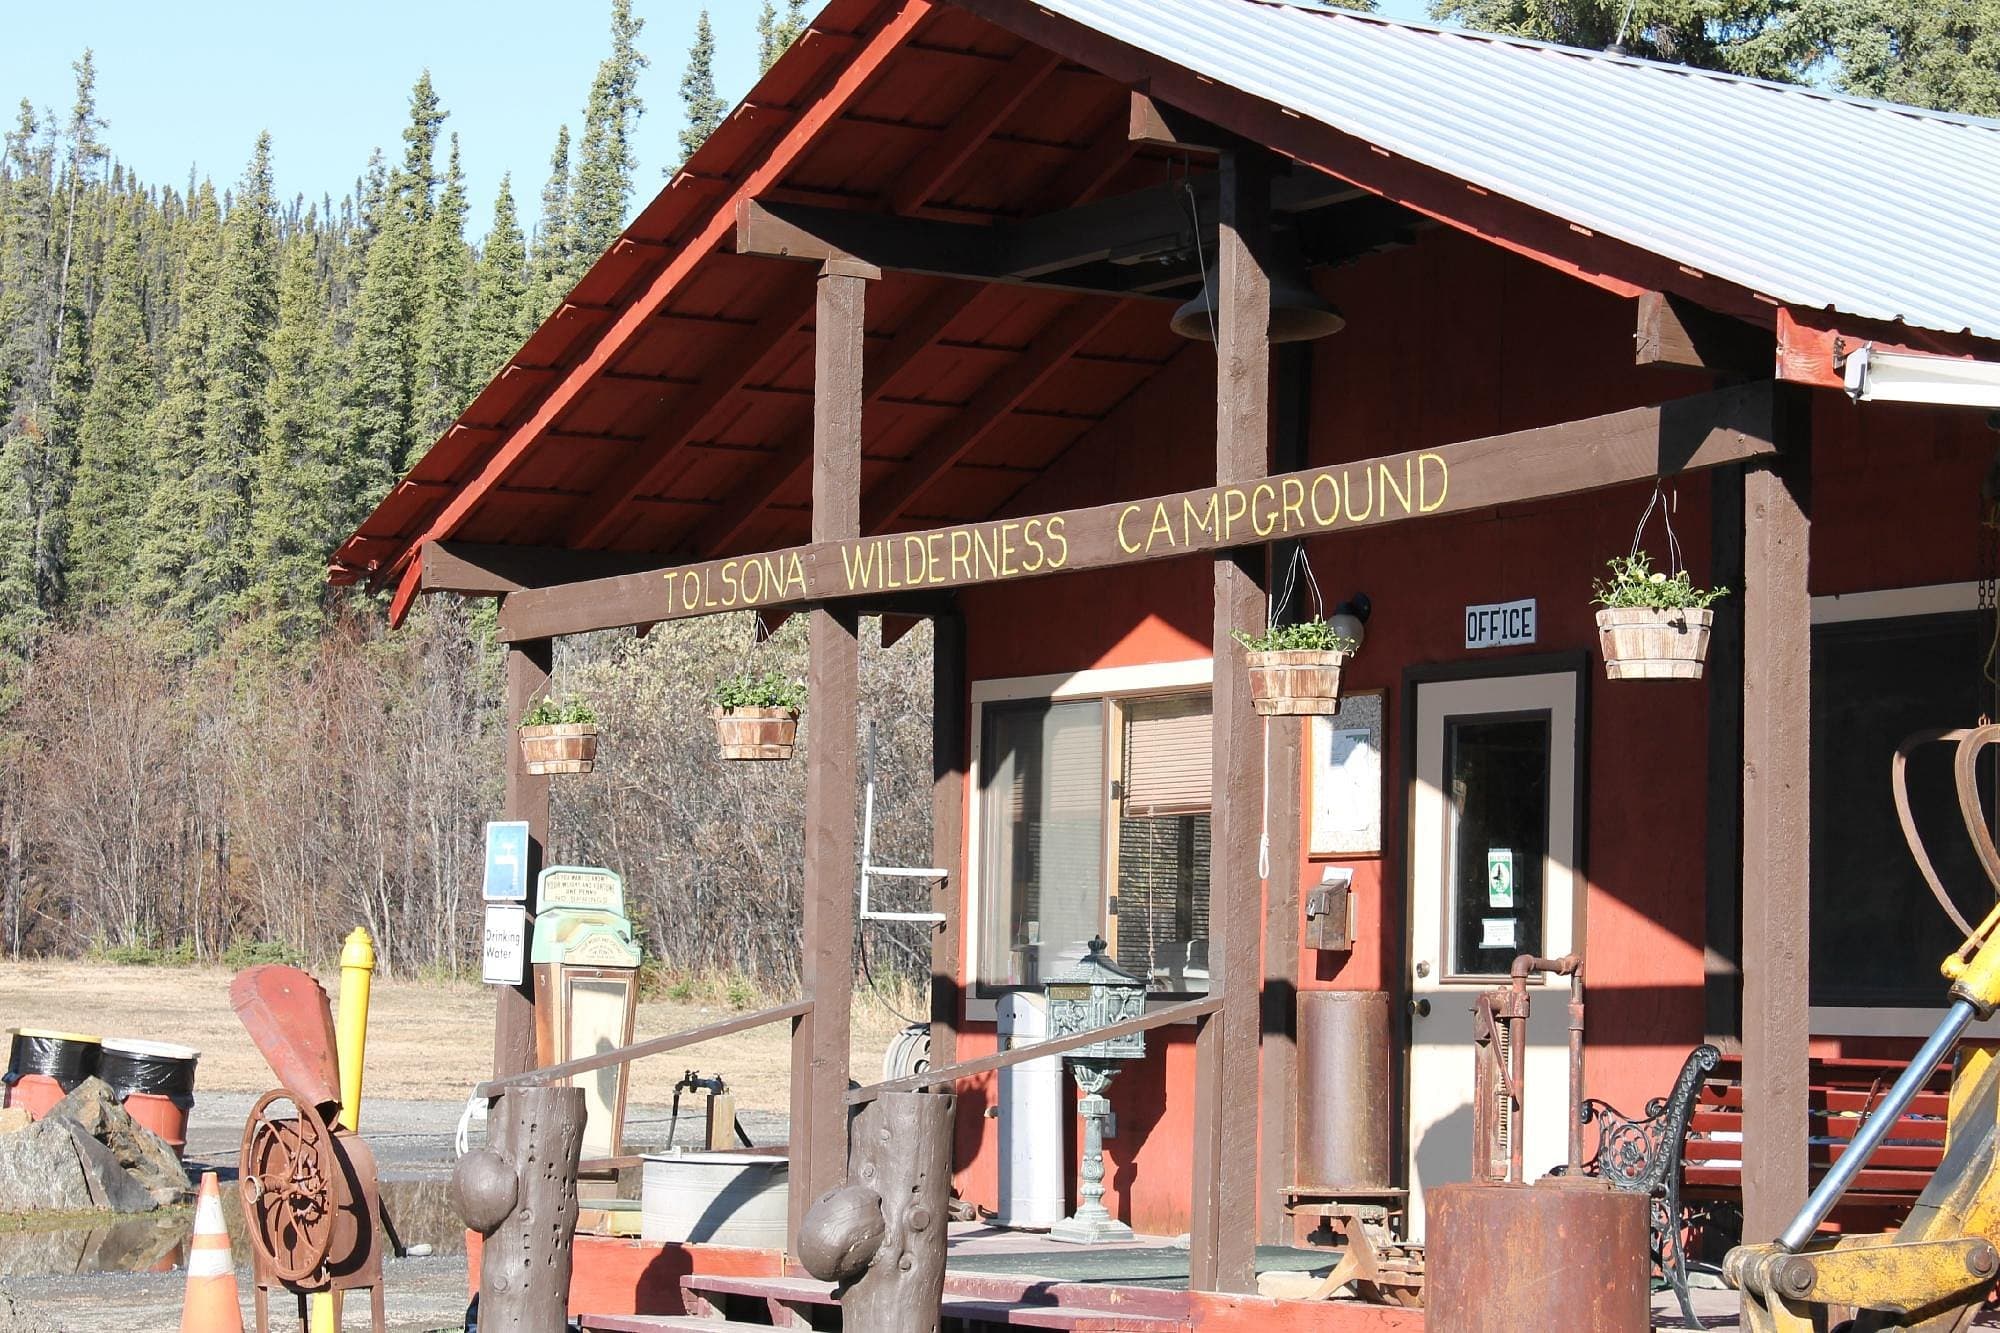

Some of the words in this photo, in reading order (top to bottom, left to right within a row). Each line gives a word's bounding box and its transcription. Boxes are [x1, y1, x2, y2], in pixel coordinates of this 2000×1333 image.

[663, 551, 808, 614] TOLSONA
[840, 515, 1069, 591] WILDERNESS
[1117, 452, 1449, 554] CAMPGROUND
[1467, 606, 1532, 642] OFFICE
[486, 929, 520, 946] Drinking
[486, 946, 511, 959] Water
